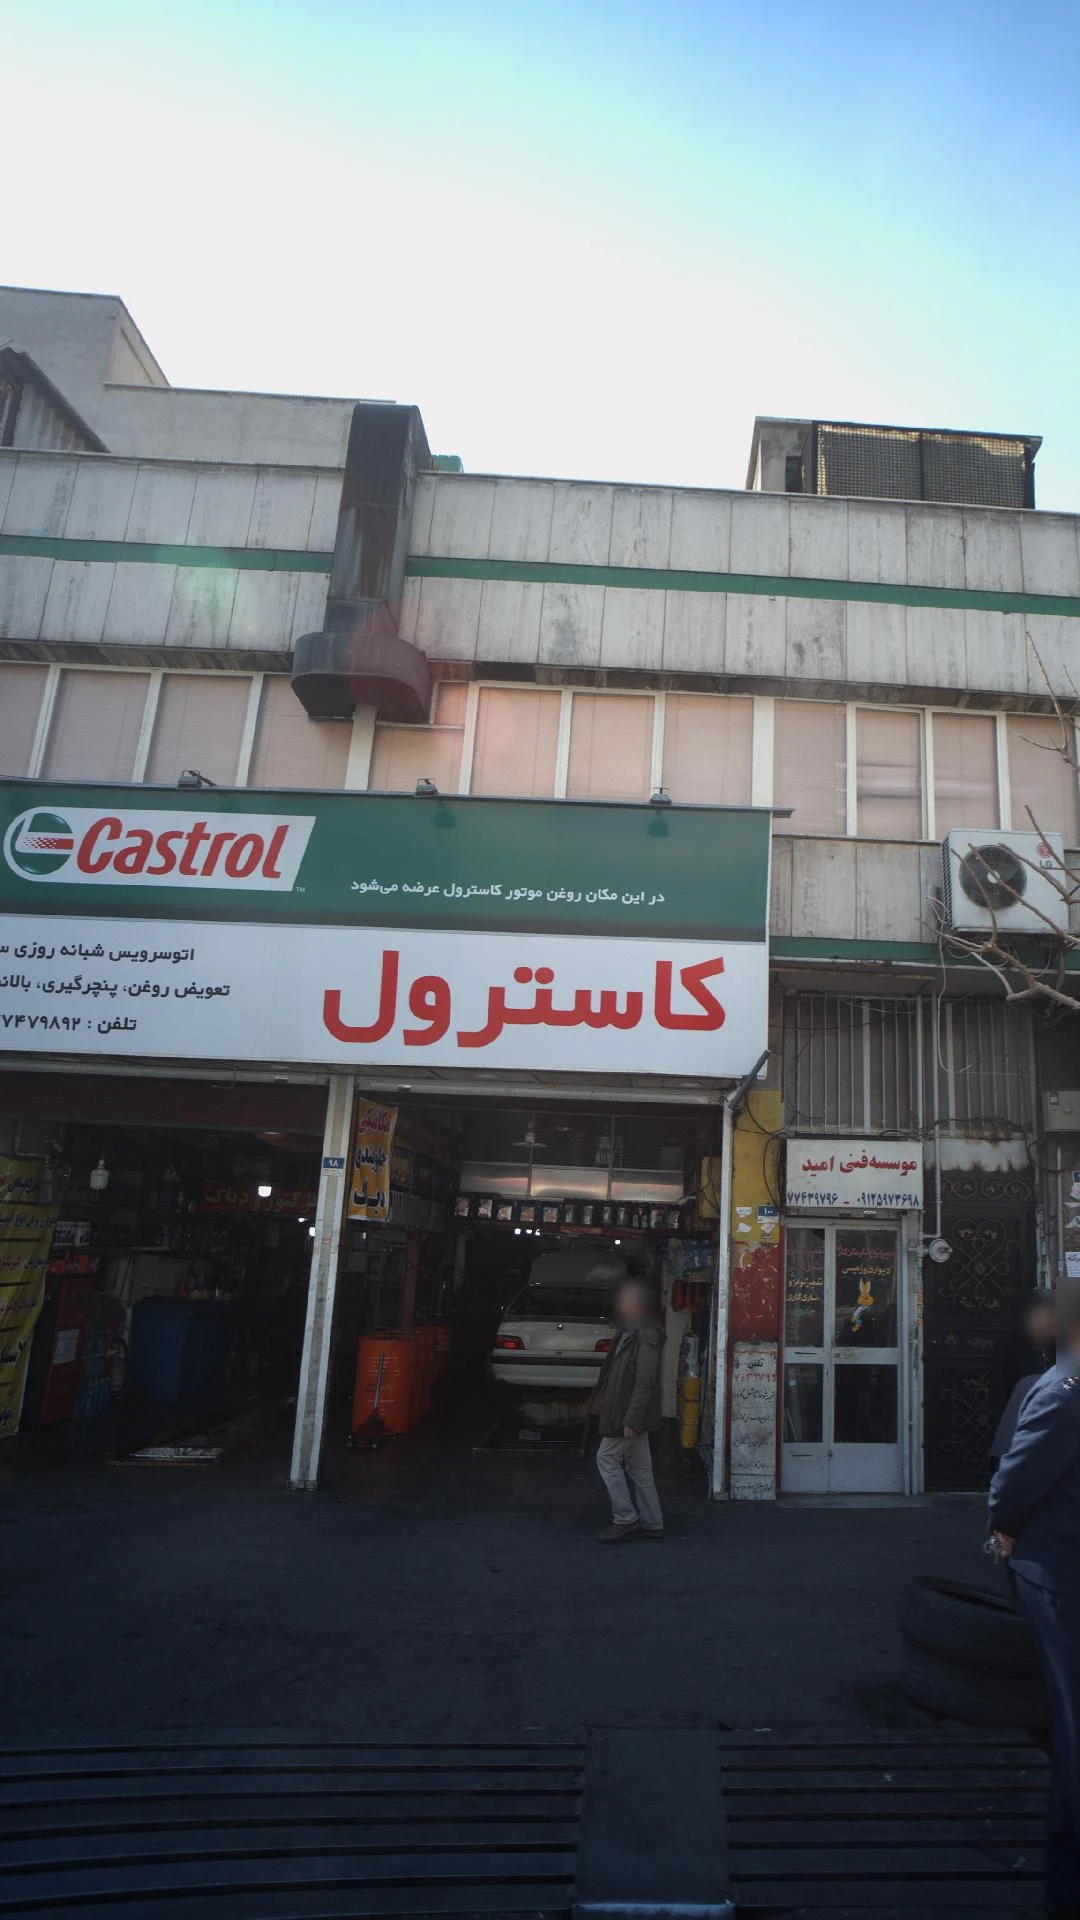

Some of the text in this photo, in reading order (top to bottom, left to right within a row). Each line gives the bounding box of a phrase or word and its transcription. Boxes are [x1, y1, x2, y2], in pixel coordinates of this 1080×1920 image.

[76, 816, 290, 879] Castrol
[1039, 860, 1053, 868] LG
[402, 882, 441, 894] عرضه
[443, 882, 503, 898] کاسترول
[505, 887, 543, 900] موتور
[546, 887, 583, 902] روغن
[585, 888, 618, 902] مکان
[621, 890, 646, 905] این
[648, 891, 666, 905] در
[14, 942, 56, 959] روزی
[60, 943, 105, 960] شبانه
[109, 949, 195, 964] اتوسرویس
[174, 984, 231, 999] تعویض
[322, 949, 727, 1049] کاسترول
[0, 1014, 81, 1031] ۷۴۷۹۸۹۲
[97, 1017, 137, 1034] تلفن
[802, 1155, 835, 1177] امید
[839, 1149, 869, 1174] فنی
[747, 1358, 765, 1370] تلفن
